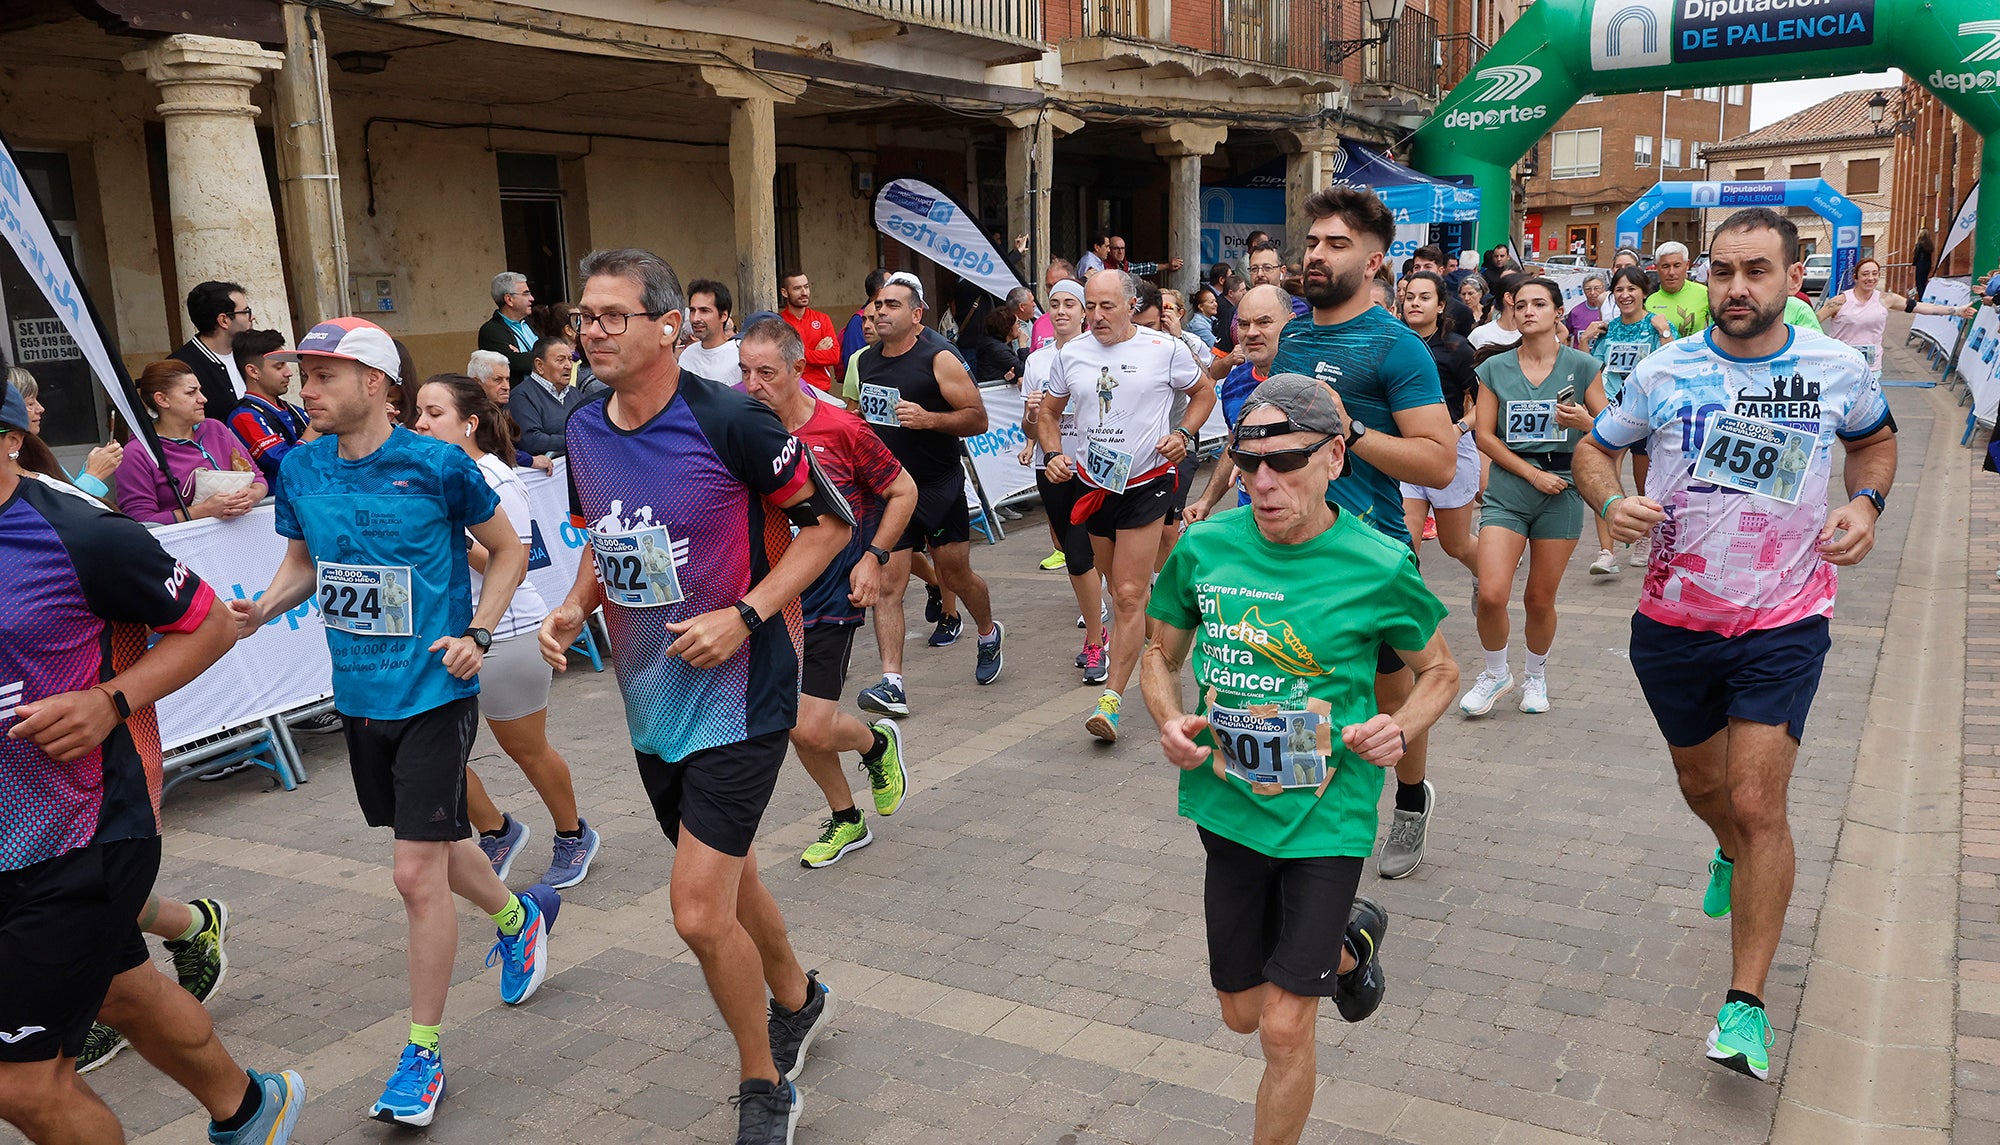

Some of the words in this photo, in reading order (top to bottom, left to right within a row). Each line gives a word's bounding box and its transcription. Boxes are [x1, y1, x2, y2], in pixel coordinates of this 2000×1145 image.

[1682, 27, 1719, 50] DE
[1727, 12, 1867, 46] PALENCIA
[1443, 104, 1547, 131] deportes
[1723, 184, 1773, 196] Diputación
[1722, 195, 1734, 203] DE
[1737, 194, 1784, 203] PALENCIA
[19, 322, 35, 336] SE
[35, 320, 68, 335] VEND
[20, 337, 40, 348] 655
[42, 336, 58, 347] 419
[24, 350, 40, 360] 671
[41, 348, 59, 359] 070
[60, 347, 79, 358] 540
[1610, 352, 1637, 366] 217
[862, 395, 888, 416] 332
[1734, 402, 1821, 419] CARRERA
[1510, 413, 1549, 433] 297
[1735, 420, 1769, 435] 10.000
[1087, 452, 1115, 478] 457
[1705, 435, 1779, 479] 458
[361, 529, 400, 538] deportes
[1203, 583, 1237, 596] Carrera
[1239, 587, 1284, 602] Palencia
[321, 584, 382, 619] 224
[1197, 594, 1216, 614] En
[350, 642, 388, 656] 10.000
[390, 640, 407, 653] de
[1202, 641, 1254, 666] contra
[380, 658, 410, 670] Haro
[1210, 666, 1286, 693] cáncer
[1215, 717, 1254, 729] MARIANO
[1254, 723, 1281, 732] HARO
[1228, 713, 1265, 726] 10.000
